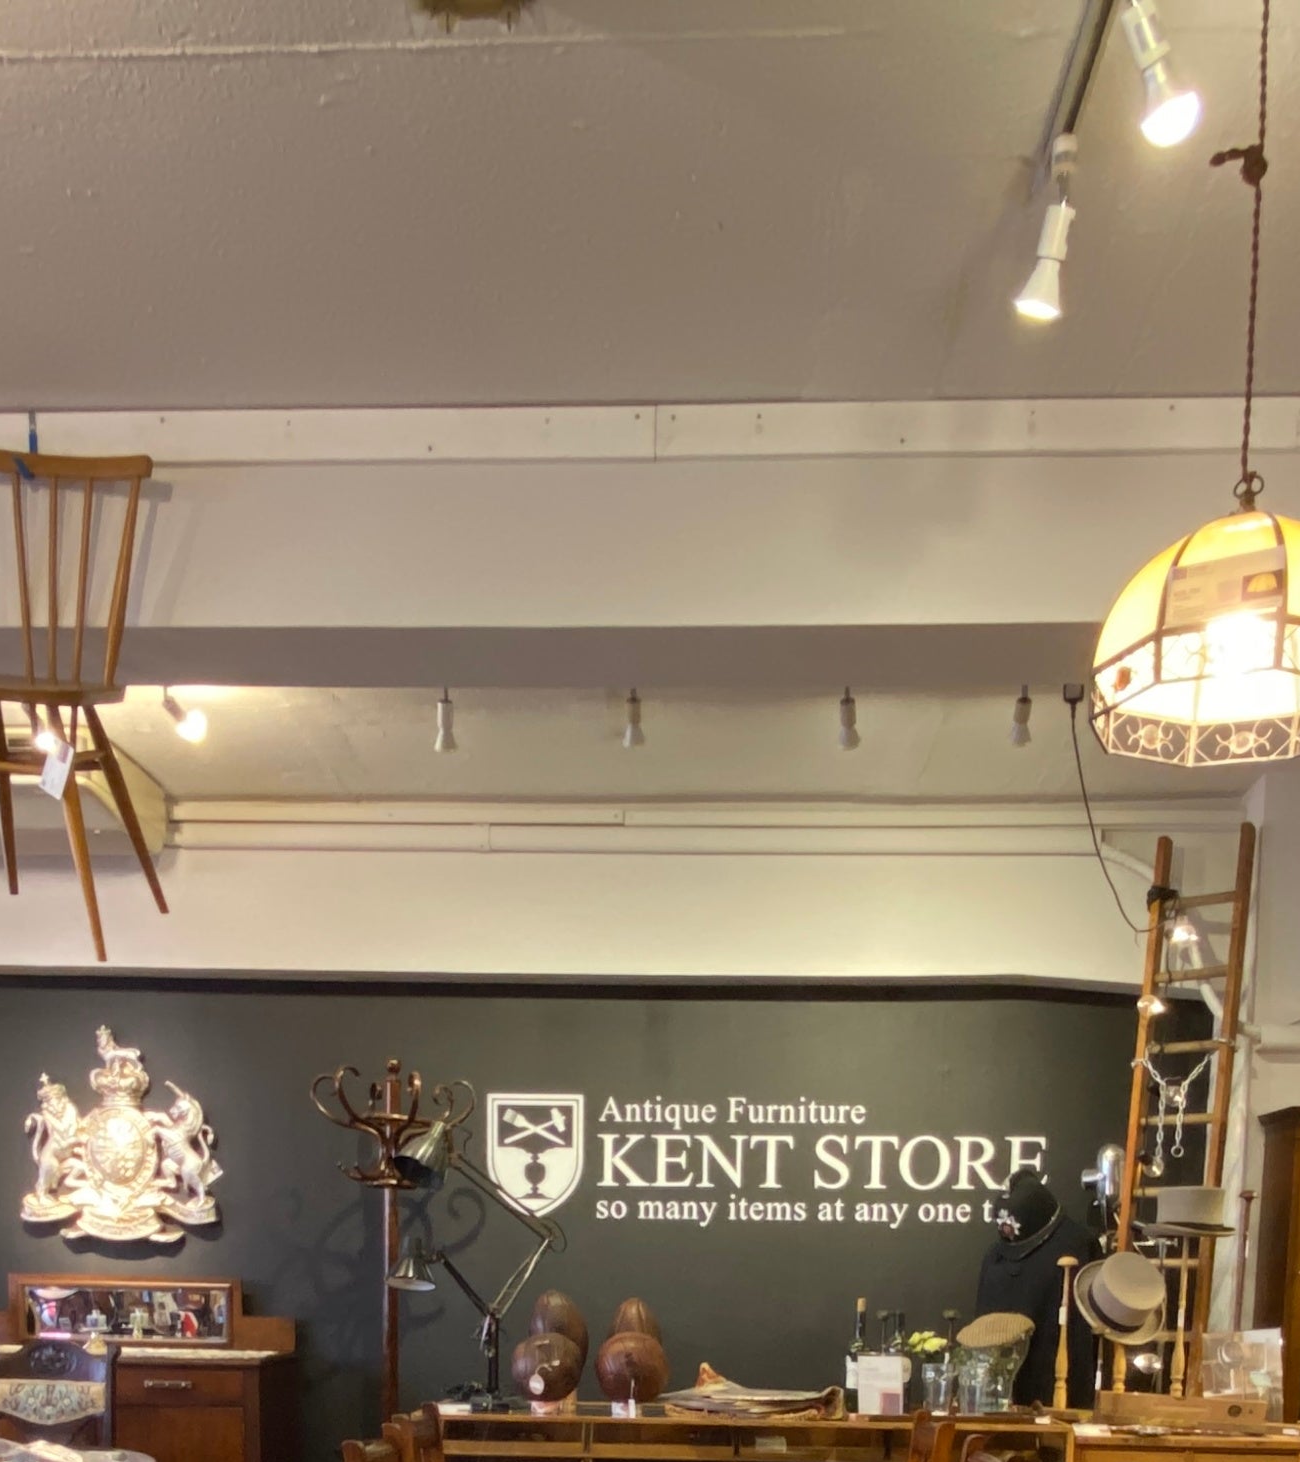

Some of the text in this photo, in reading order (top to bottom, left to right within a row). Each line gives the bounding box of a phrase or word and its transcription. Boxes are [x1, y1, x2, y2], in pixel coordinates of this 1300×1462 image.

[598, 1094, 868, 1131] Antique Furniture
[596, 1132, 1049, 1192] KENT STORE
[595, 1199, 628, 1220] so
[637, 1200, 717, 1227] many
[727, 1193, 807, 1221] items
[817, 1197, 845, 1222] at
[854, 1202, 909, 1229] any
[917, 1203, 971, 1223] one
